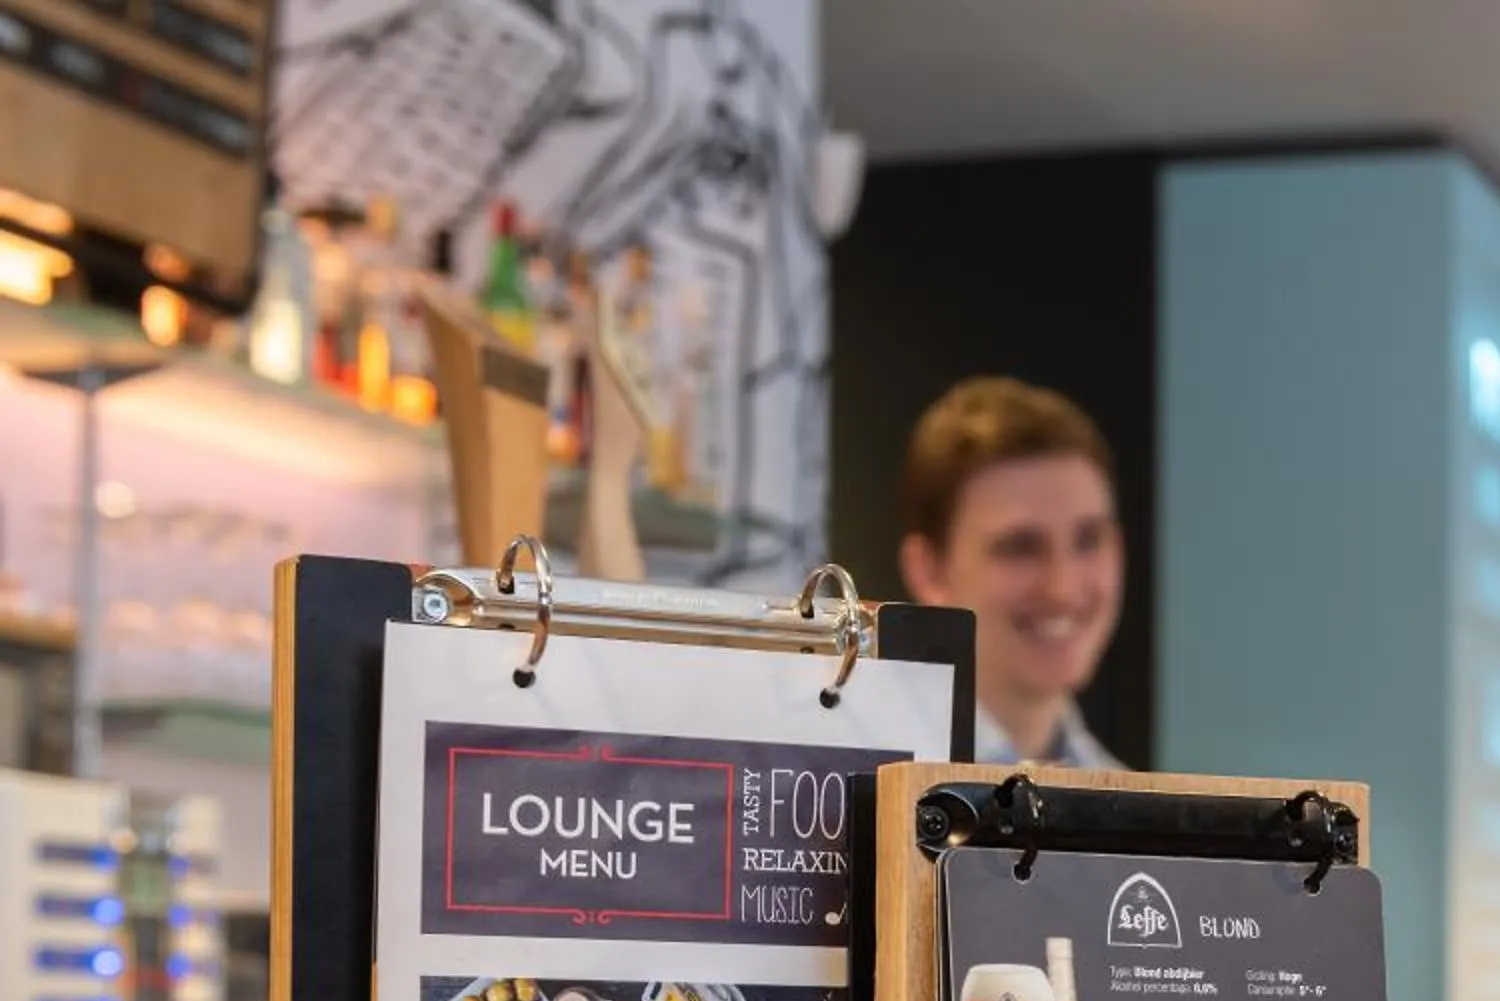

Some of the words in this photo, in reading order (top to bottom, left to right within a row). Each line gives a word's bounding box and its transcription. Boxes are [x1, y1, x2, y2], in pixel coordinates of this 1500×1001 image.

[481, 791, 695, 844] LOUNGE
[742, 767, 761, 836] TASTY
[769, 768, 856, 841] FOO
[539, 848, 638, 880] MENU
[743, 847, 848, 875] RELAXIN
[741, 884, 814, 925] MUSIC
[1117, 904, 1170, 938] Leffe
[1199, 915, 1261, 940] BLOND
